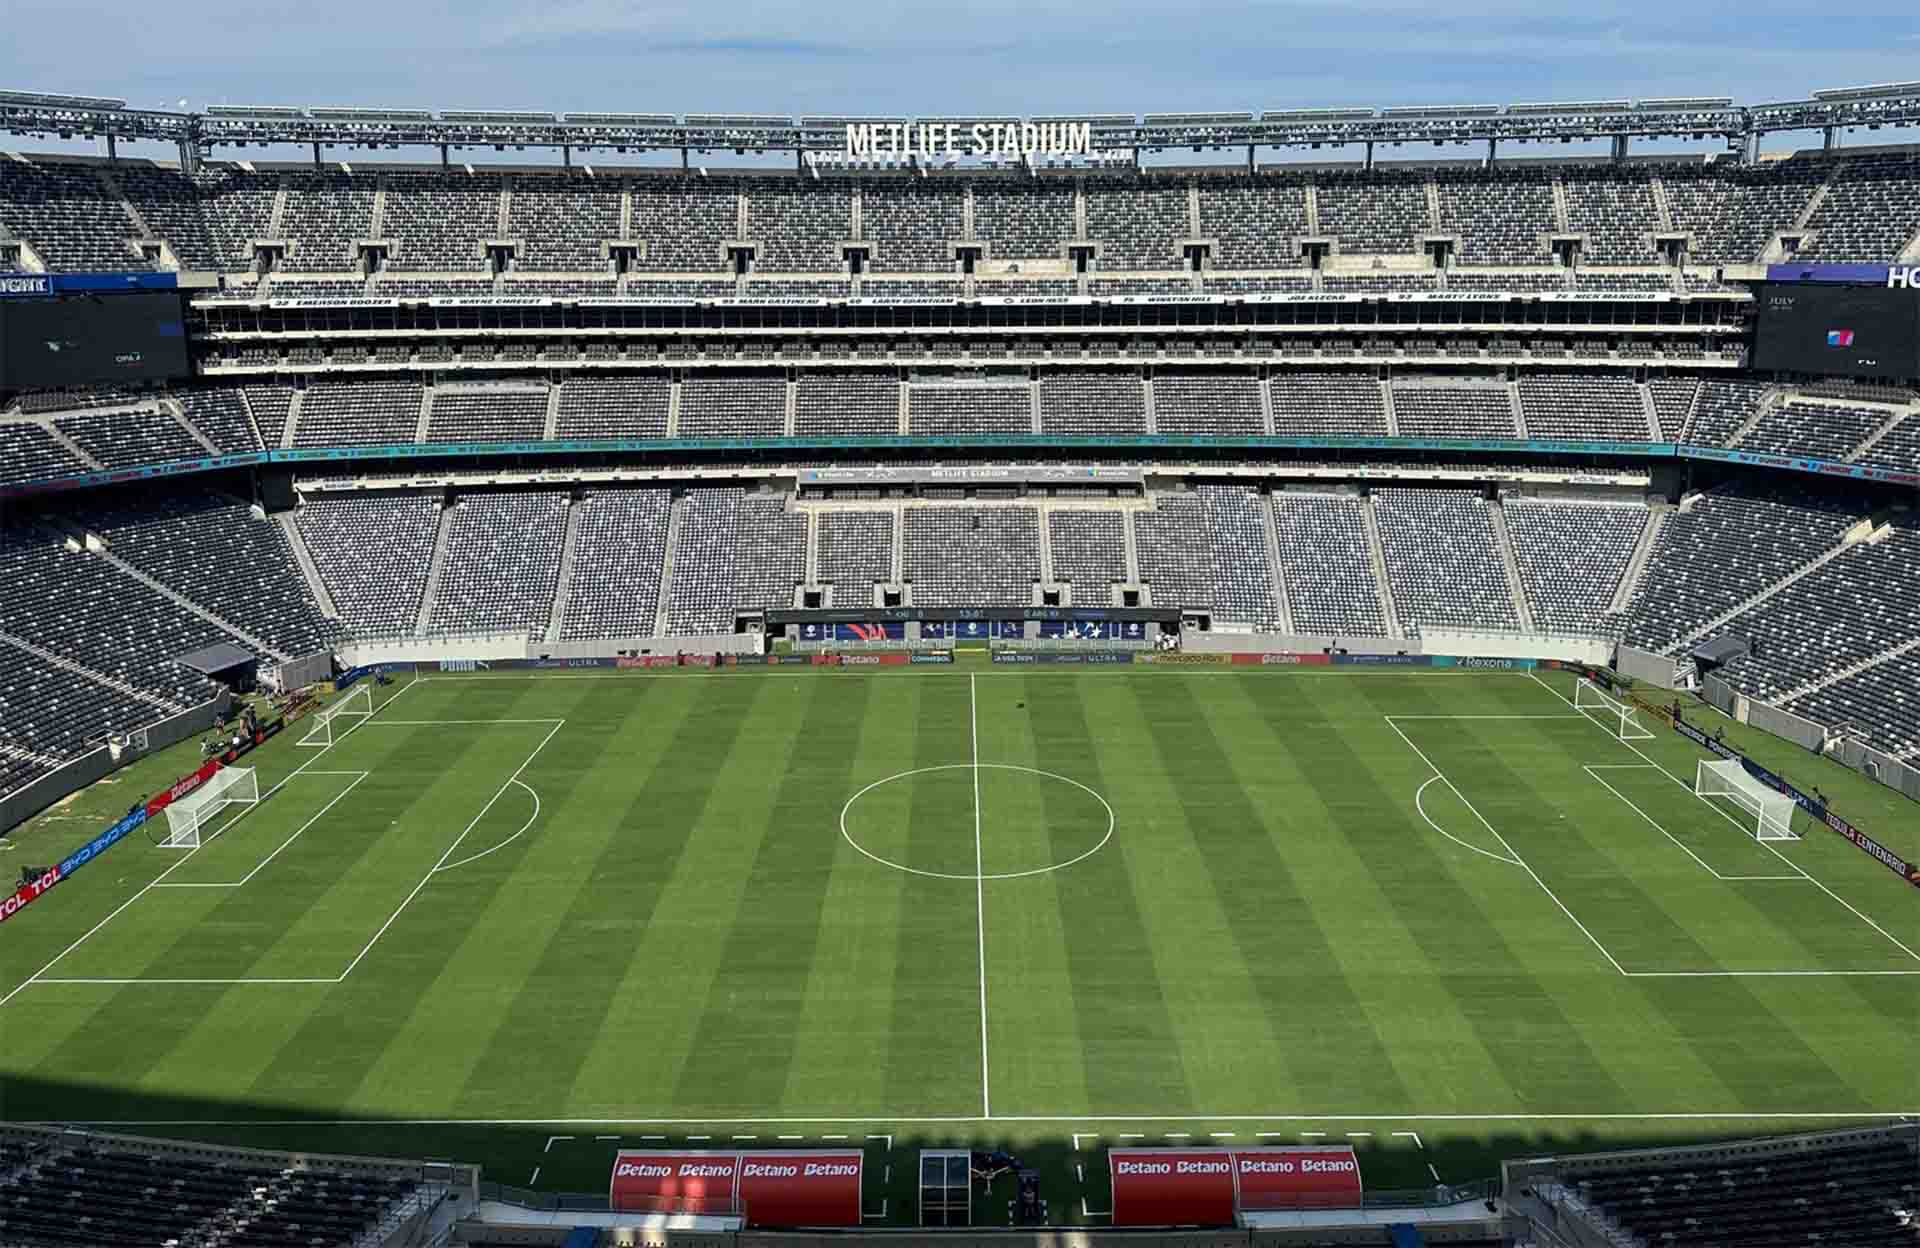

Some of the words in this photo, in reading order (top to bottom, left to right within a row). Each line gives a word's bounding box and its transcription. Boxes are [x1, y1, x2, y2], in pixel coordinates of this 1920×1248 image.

[846, 123, 961, 154] METLIFE
[971, 122, 1091, 154] STADIUM
[841, 655, 880, 665] Betano
[1466, 657, 1513, 669] Rexona
[62, 849, 91, 873] BYD
[95, 829, 120, 852] BYD
[1825, 813, 1855, 841] TEQUILA
[1856, 832, 1906, 875] CENTENARIO
[32, 868, 61, 895] TCL
[617, 1163, 672, 1177] Betano
[678, 1163, 733, 1177] Betano
[743, 1163, 797, 1177] Betano
[804, 1162, 858, 1176] Betano
[1118, 1161, 1171, 1174] Betano
[1176, 1160, 1230, 1174] Betano
[1240, 1159, 1294, 1173] Betano
[1301, 1158, 1354, 1172] Betano
